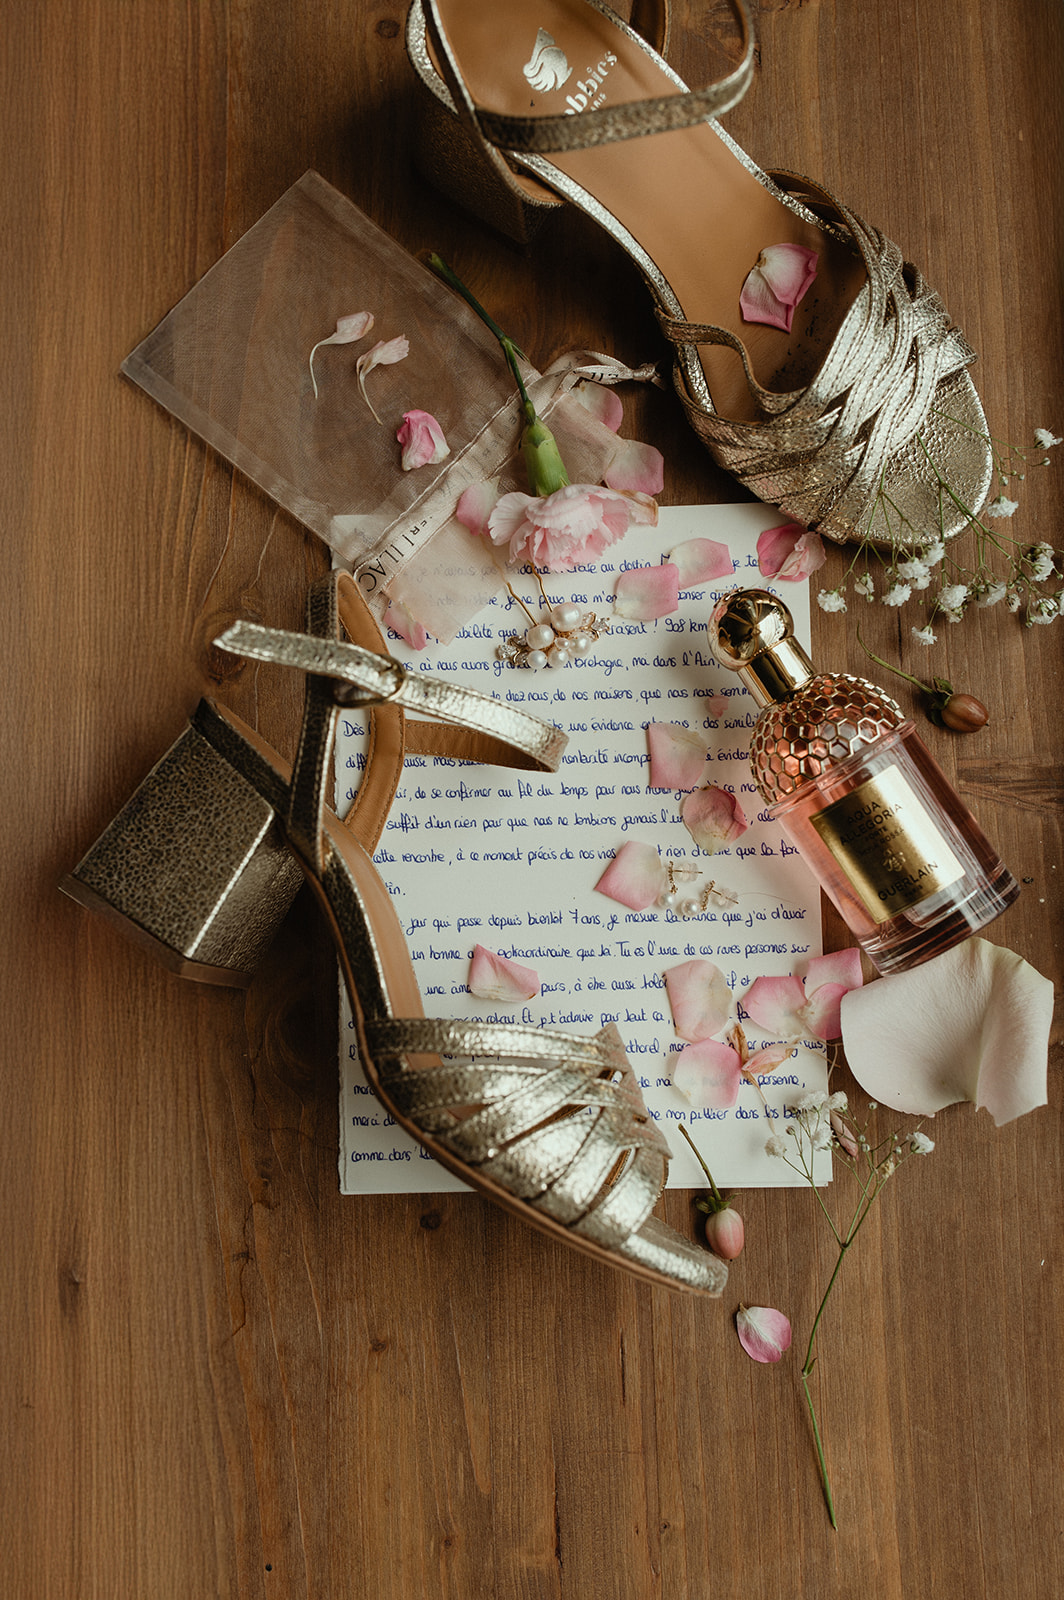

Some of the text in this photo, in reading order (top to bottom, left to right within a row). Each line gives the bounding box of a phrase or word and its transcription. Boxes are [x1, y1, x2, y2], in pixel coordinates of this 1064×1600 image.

[563, 51, 617, 115] bbies
[839, 803, 903, 846] ALLEGORIA
[847, 801, 880, 824] AQUA
[877, 861, 939, 901] GUERLAIN
